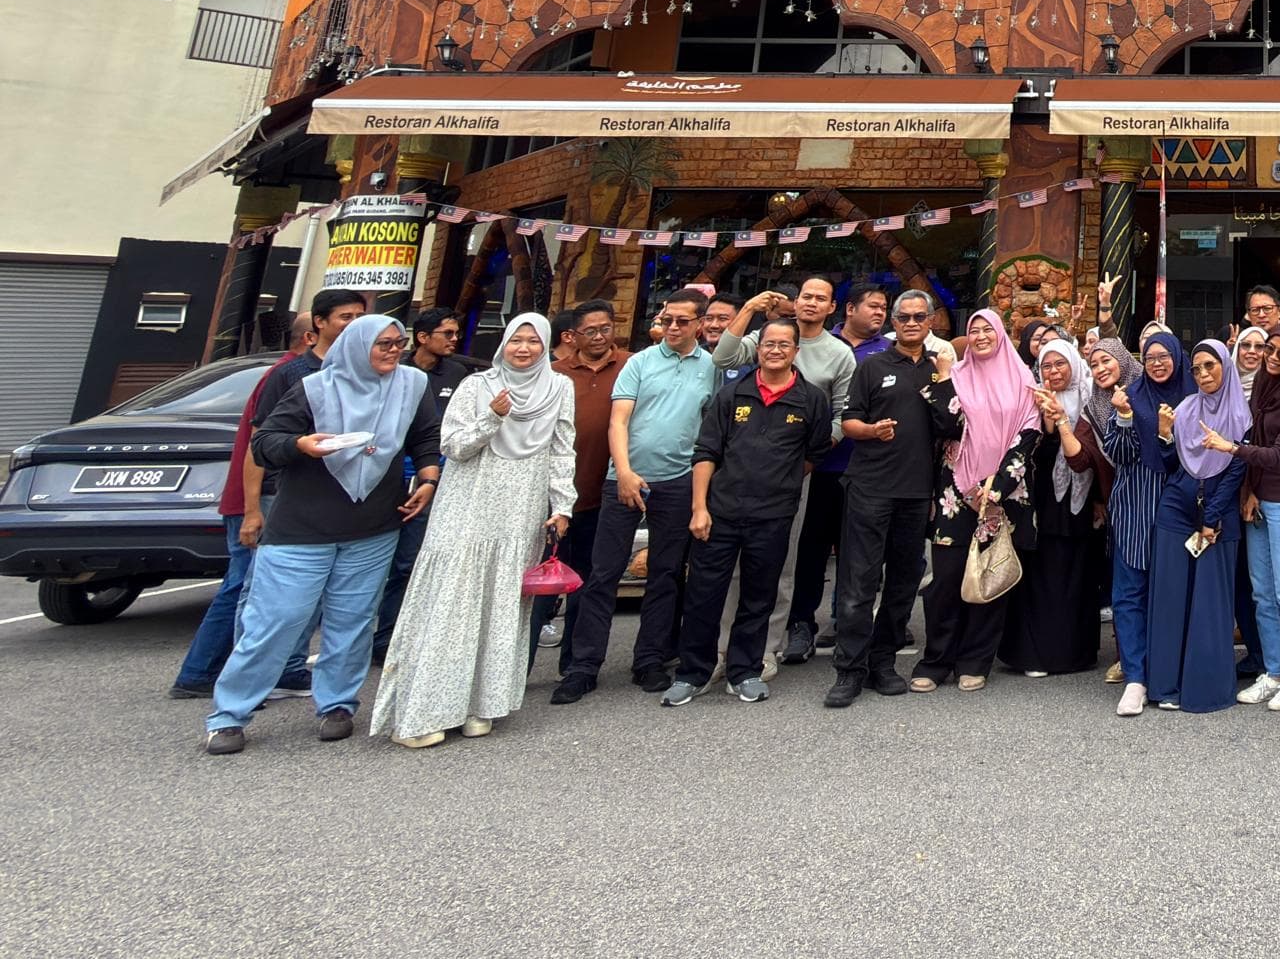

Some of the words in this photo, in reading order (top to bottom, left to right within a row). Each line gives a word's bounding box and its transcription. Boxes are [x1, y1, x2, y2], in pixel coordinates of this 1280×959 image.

[364, 115, 431, 129] Restoran
[435, 115, 500, 130] Alkhalifa
[599, 117, 664, 131] Restoran
[669, 117, 731, 131] Alkhalifa
[826, 118, 892, 132] Restoran
[895, 119, 956, 133] Alkhalifa
[1103, 117, 1165, 130] Restoran
[1169, 117, 1229, 131] Alkhalifa
[360, 222, 419, 242] KOSONG
[385, 272, 409, 285] 3981
[96, 471, 130, 486] JXM
[130, 471, 163, 486] 898
